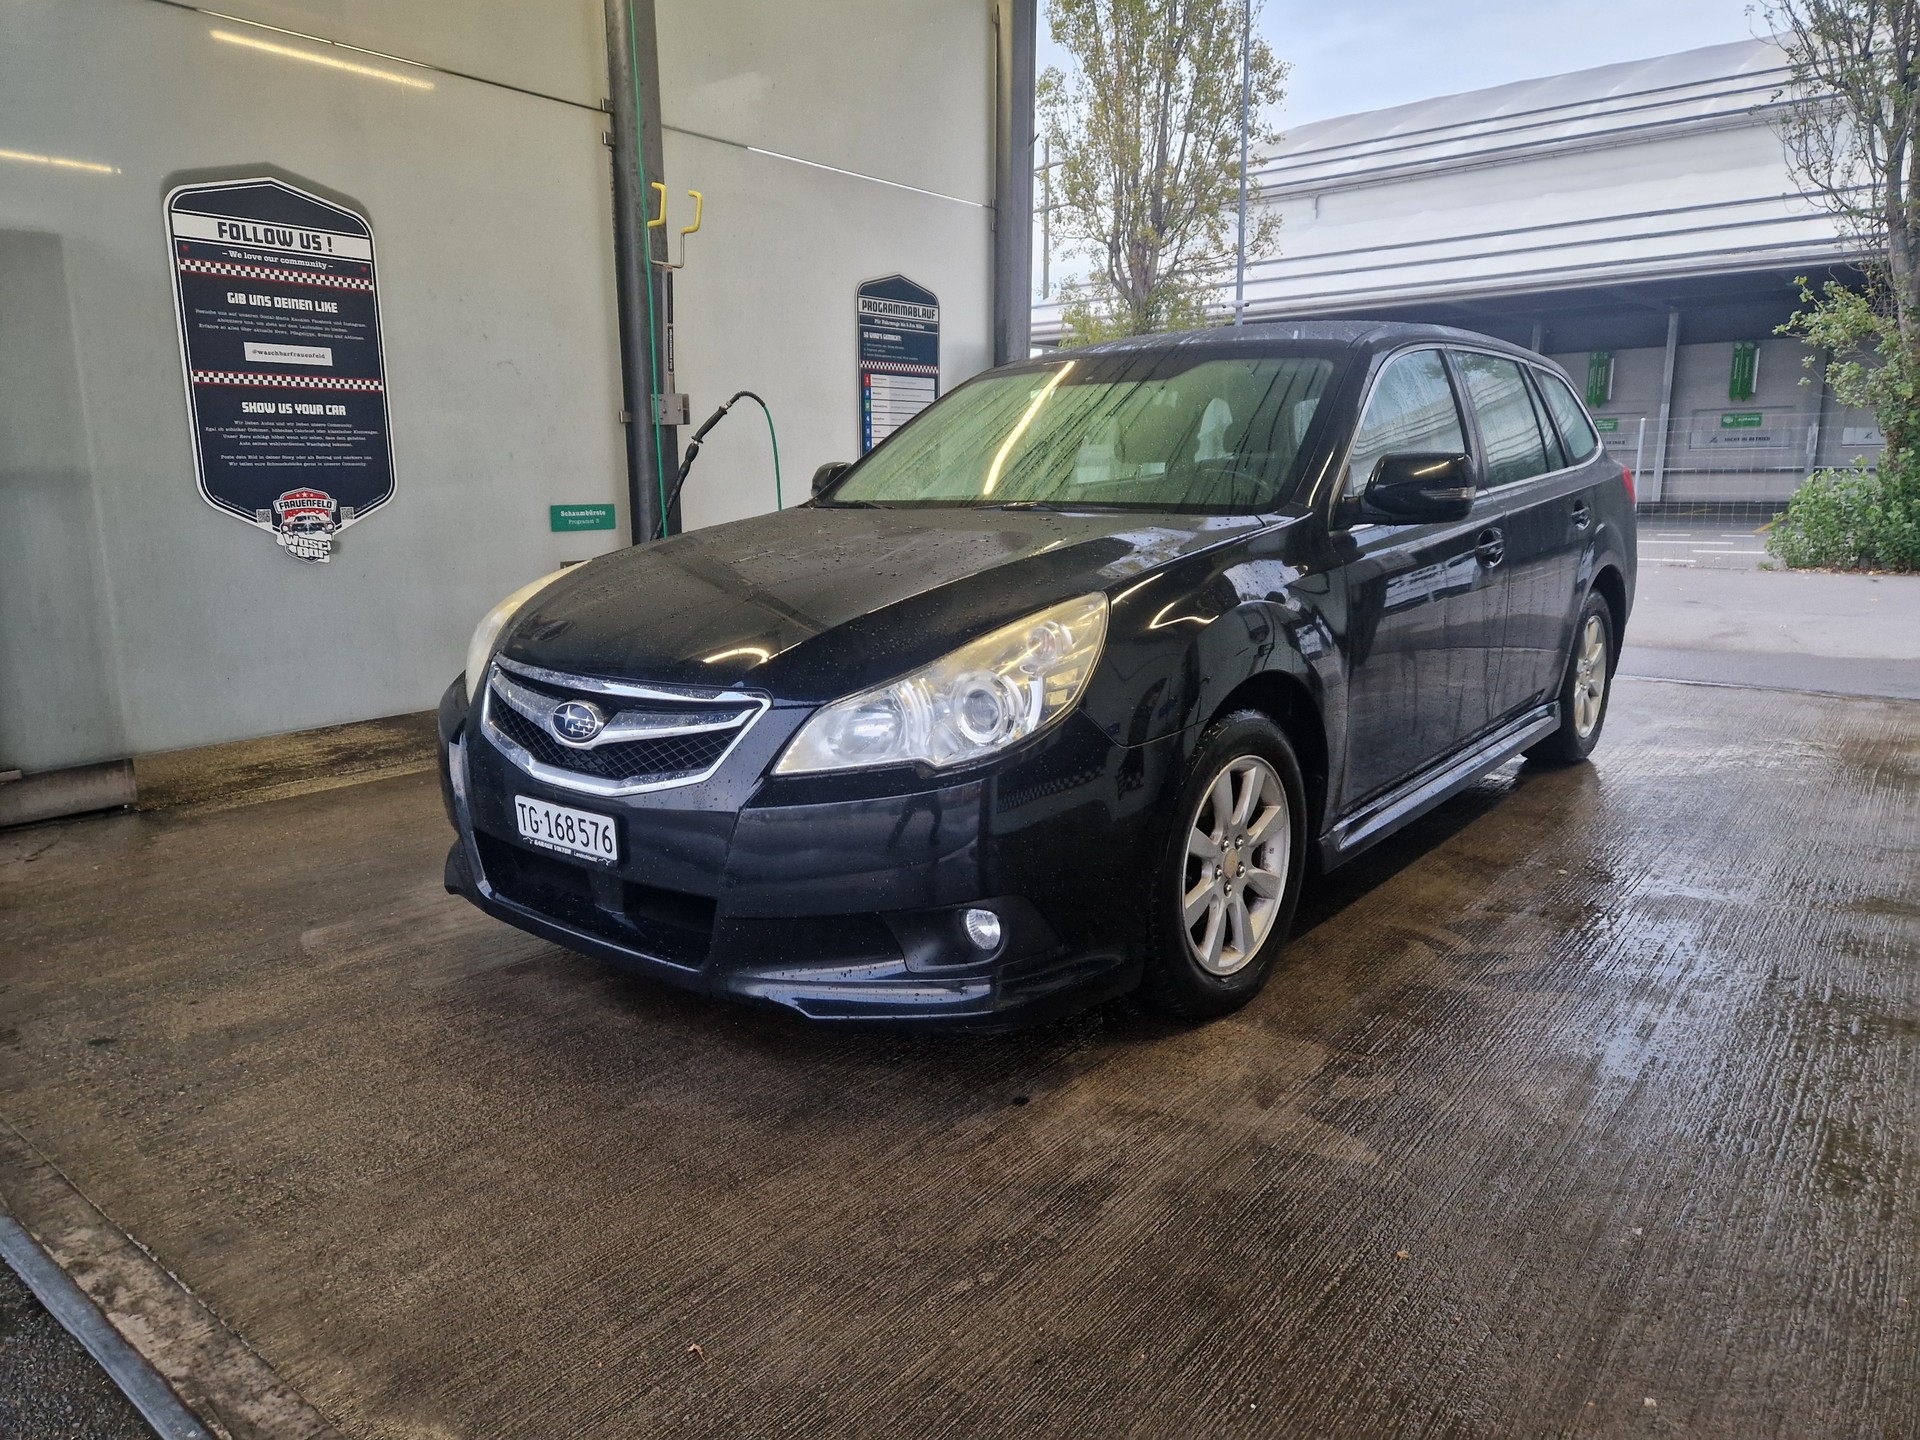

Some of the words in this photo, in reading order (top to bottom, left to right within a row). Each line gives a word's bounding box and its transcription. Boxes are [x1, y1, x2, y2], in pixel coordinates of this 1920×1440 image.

[217, 222, 293, 248] FOLLOW
[299, 234, 323, 251] US
[244, 252, 262, 261] love
[264, 255, 279, 264] our
[227, 291, 246, 305] GIB
[248, 294, 272, 307] UNS
[274, 296, 313, 311] DEINEN
[315, 300, 338, 314] LIKE
[862, 300, 936, 320] PROGRAMMABLAUF
[241, 401, 276, 414] SHOW
[278, 403, 294, 415] US
[295, 404, 324, 416] YOUR
[325, 404, 346, 416] CAR
[278, 498, 333, 510] FRAUENFELD
[560, 509, 606, 517] Schaumbürste
